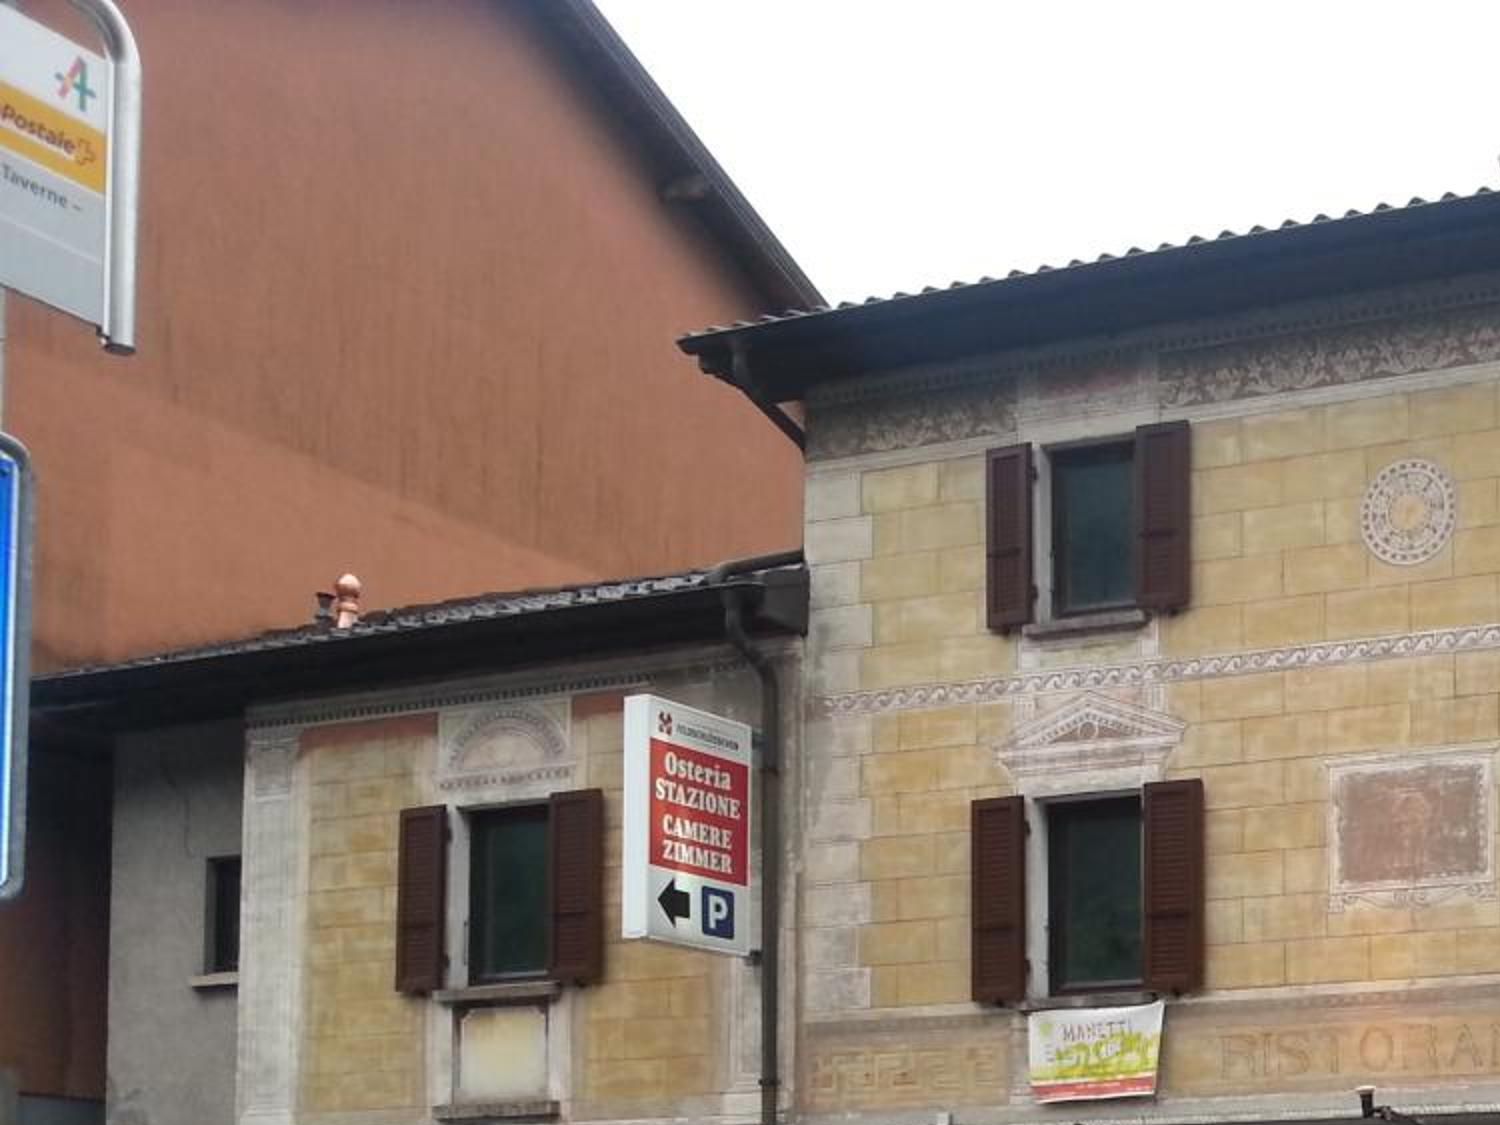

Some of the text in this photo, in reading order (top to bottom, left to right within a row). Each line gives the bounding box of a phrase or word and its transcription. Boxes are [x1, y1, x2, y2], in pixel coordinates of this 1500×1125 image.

[1, 103, 77, 156] Postale
[2, 163, 69, 209] Taverne
[664, 751, 731, 790] Osteria
[655, 777, 741, 820] STAZIONE
[662, 813, 733, 851] CAMERE
[663, 839, 734, 875] ZIMMER
[709, 894, 729, 930] P
